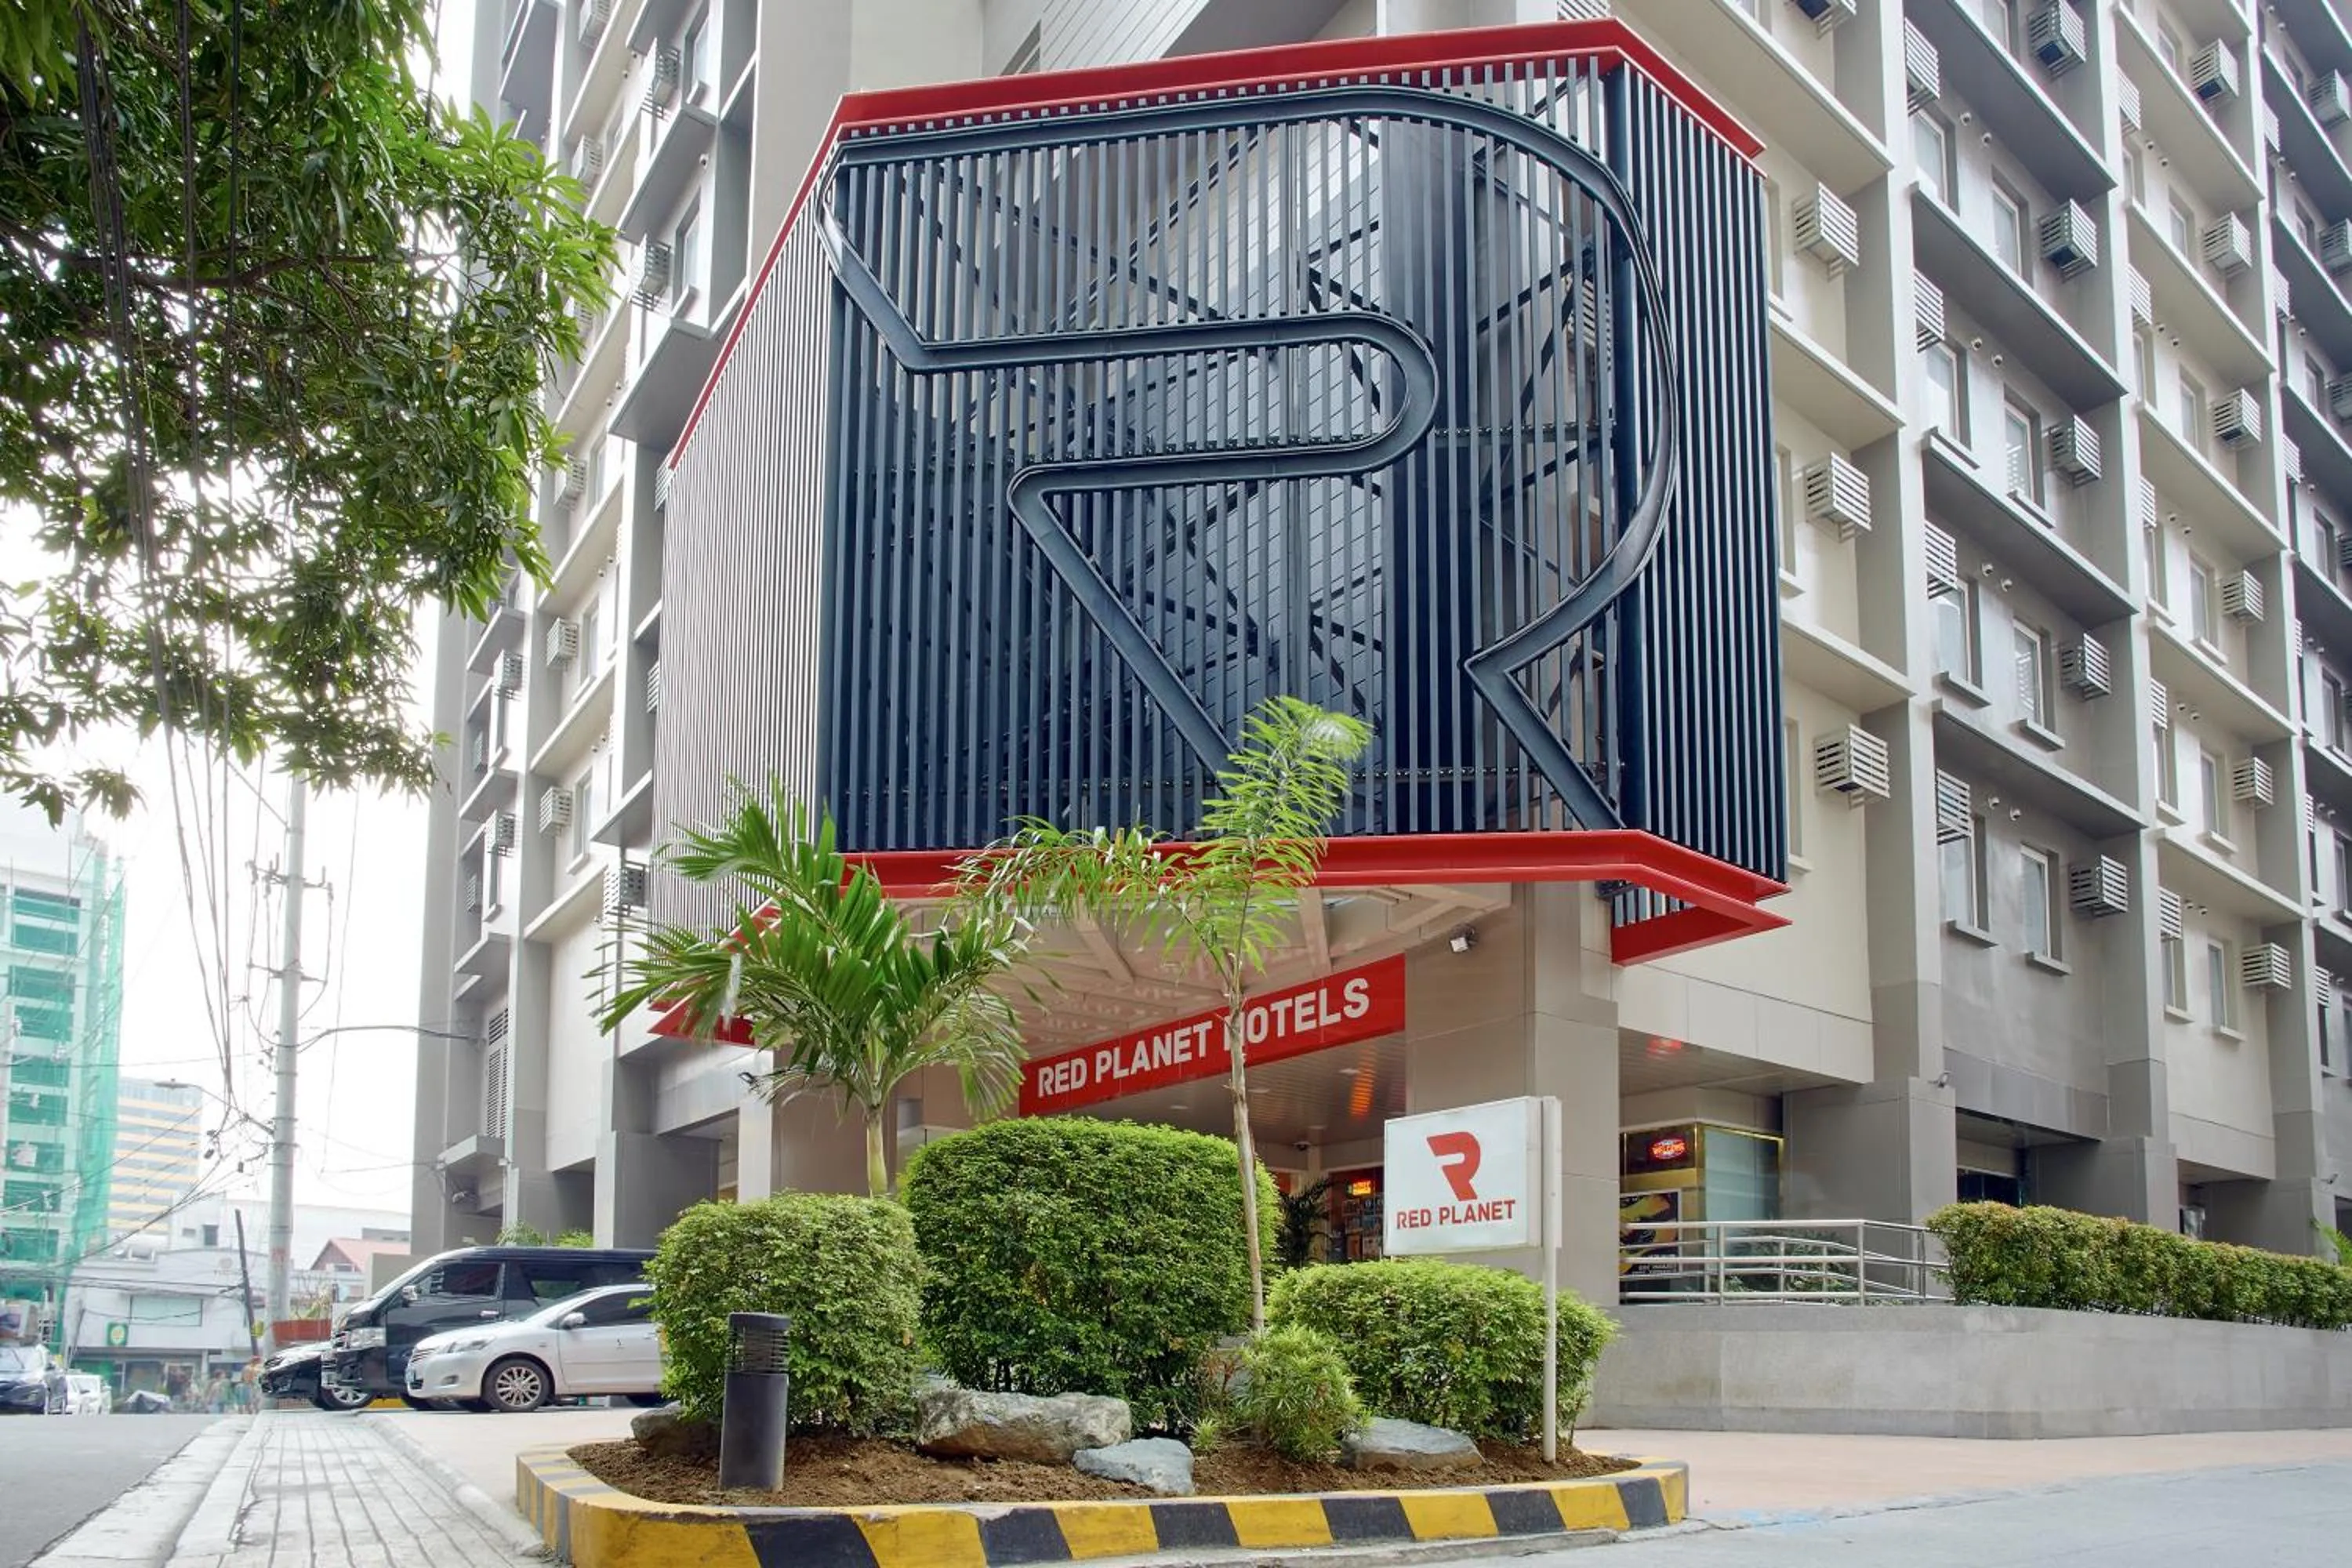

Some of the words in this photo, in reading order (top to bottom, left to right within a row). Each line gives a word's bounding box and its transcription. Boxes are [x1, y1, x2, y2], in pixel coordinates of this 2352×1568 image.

[1038, 1058, 1087, 1097] RED
[1095, 1021, 1214, 1083] PLANET
[1426, 1131, 1481, 1201] R
[1396, 1210, 1432, 1229] RED
[1439, 1200, 1515, 1225] PLANET
